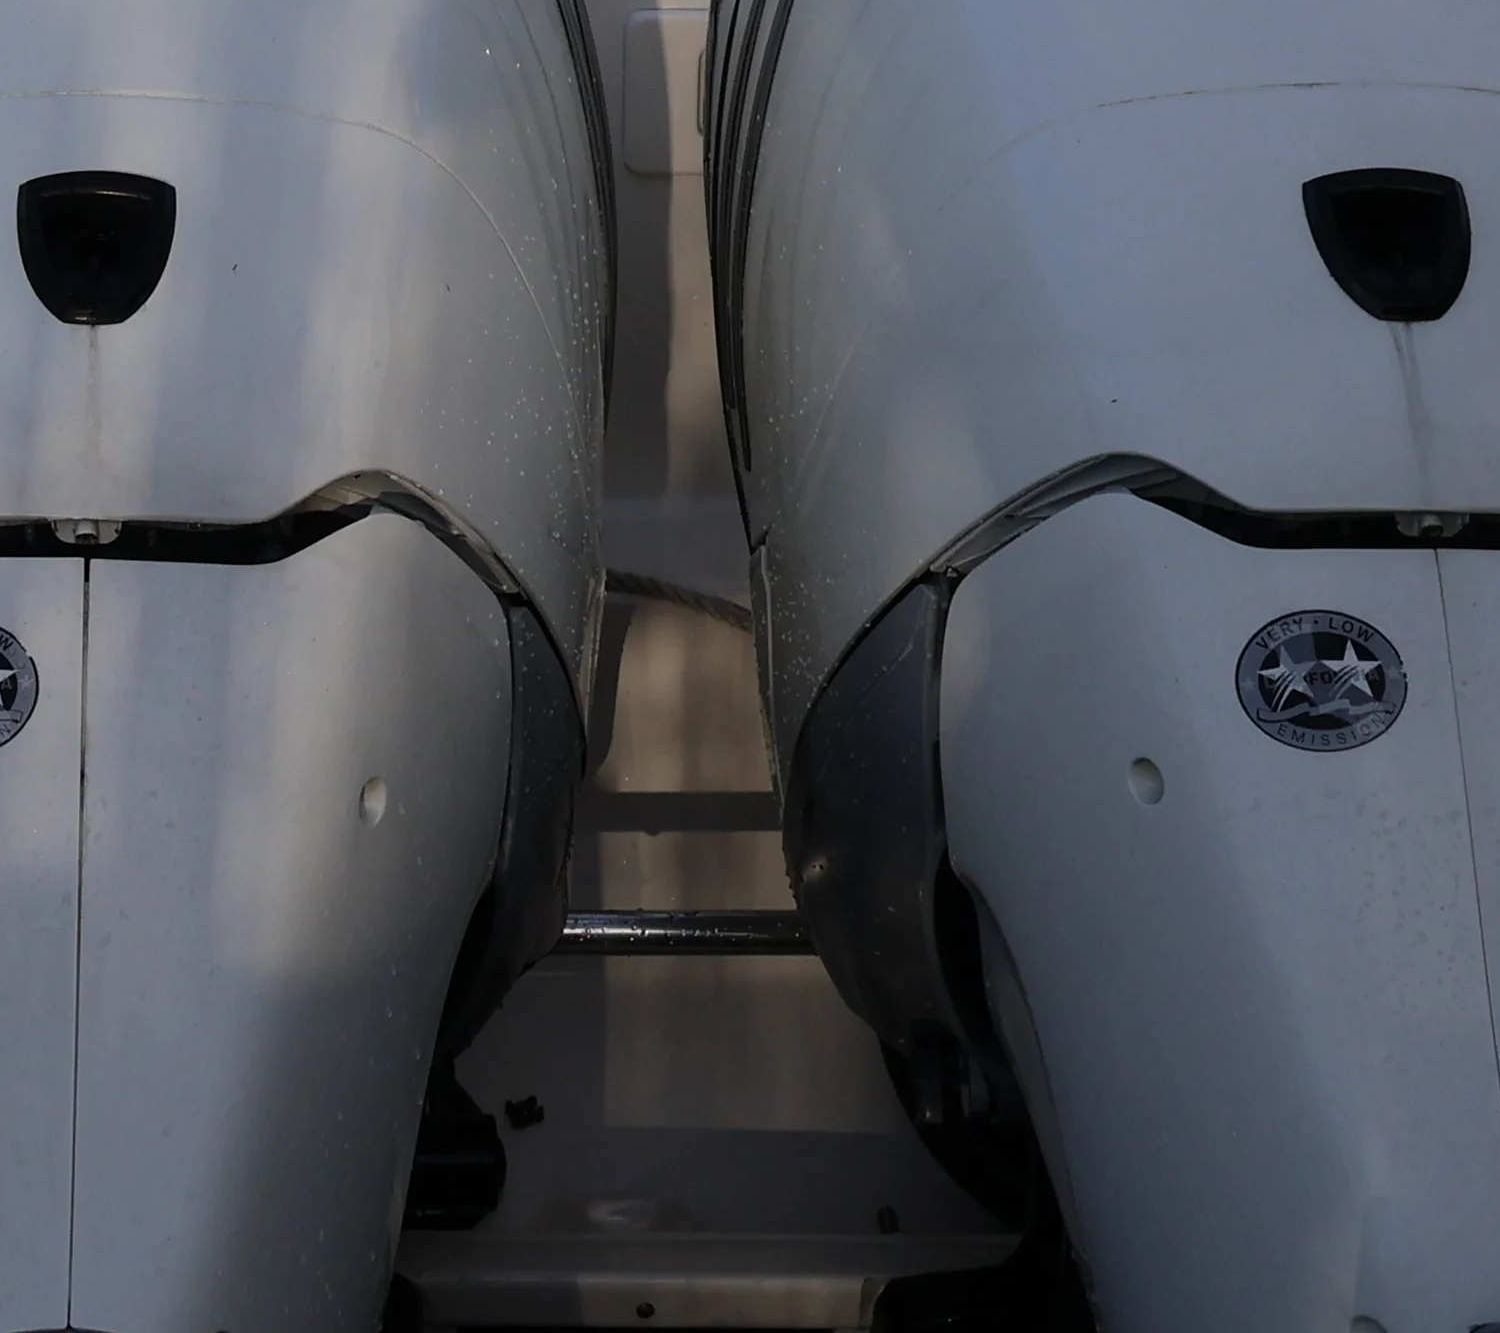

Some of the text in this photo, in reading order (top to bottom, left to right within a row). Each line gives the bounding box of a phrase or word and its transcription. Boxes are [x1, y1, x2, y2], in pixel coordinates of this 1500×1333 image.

[1255, 616, 1376, 650] VERY LOW
[1275, 713, 1387, 746] EMISSION
